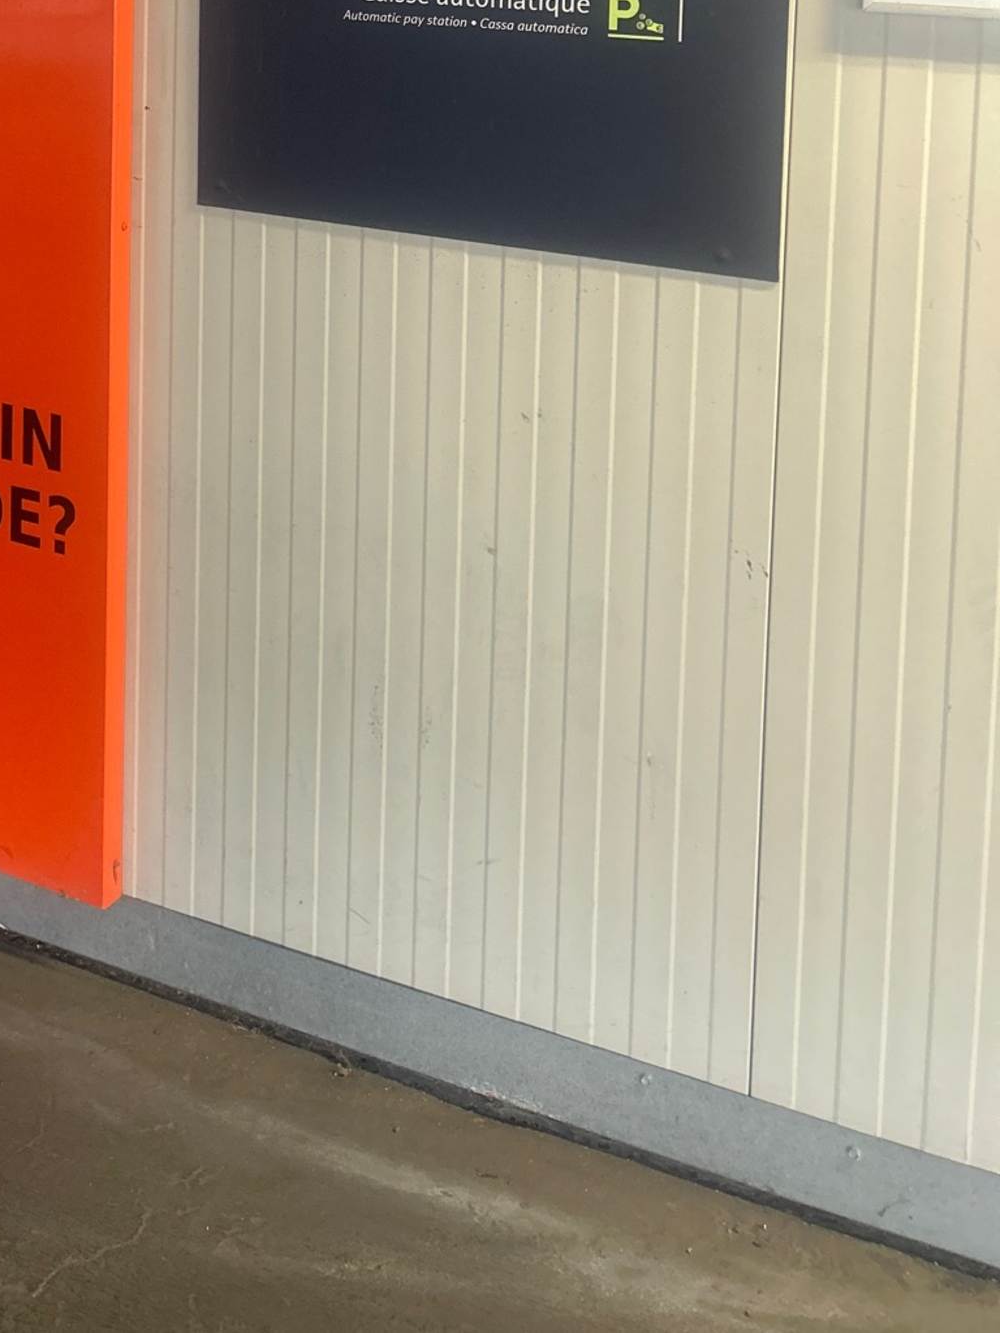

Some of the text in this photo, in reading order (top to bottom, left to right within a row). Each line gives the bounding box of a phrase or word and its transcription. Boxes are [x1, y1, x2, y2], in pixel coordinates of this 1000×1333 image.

[343, 10, 588, 35] Automatic pay station Cassa automatica
